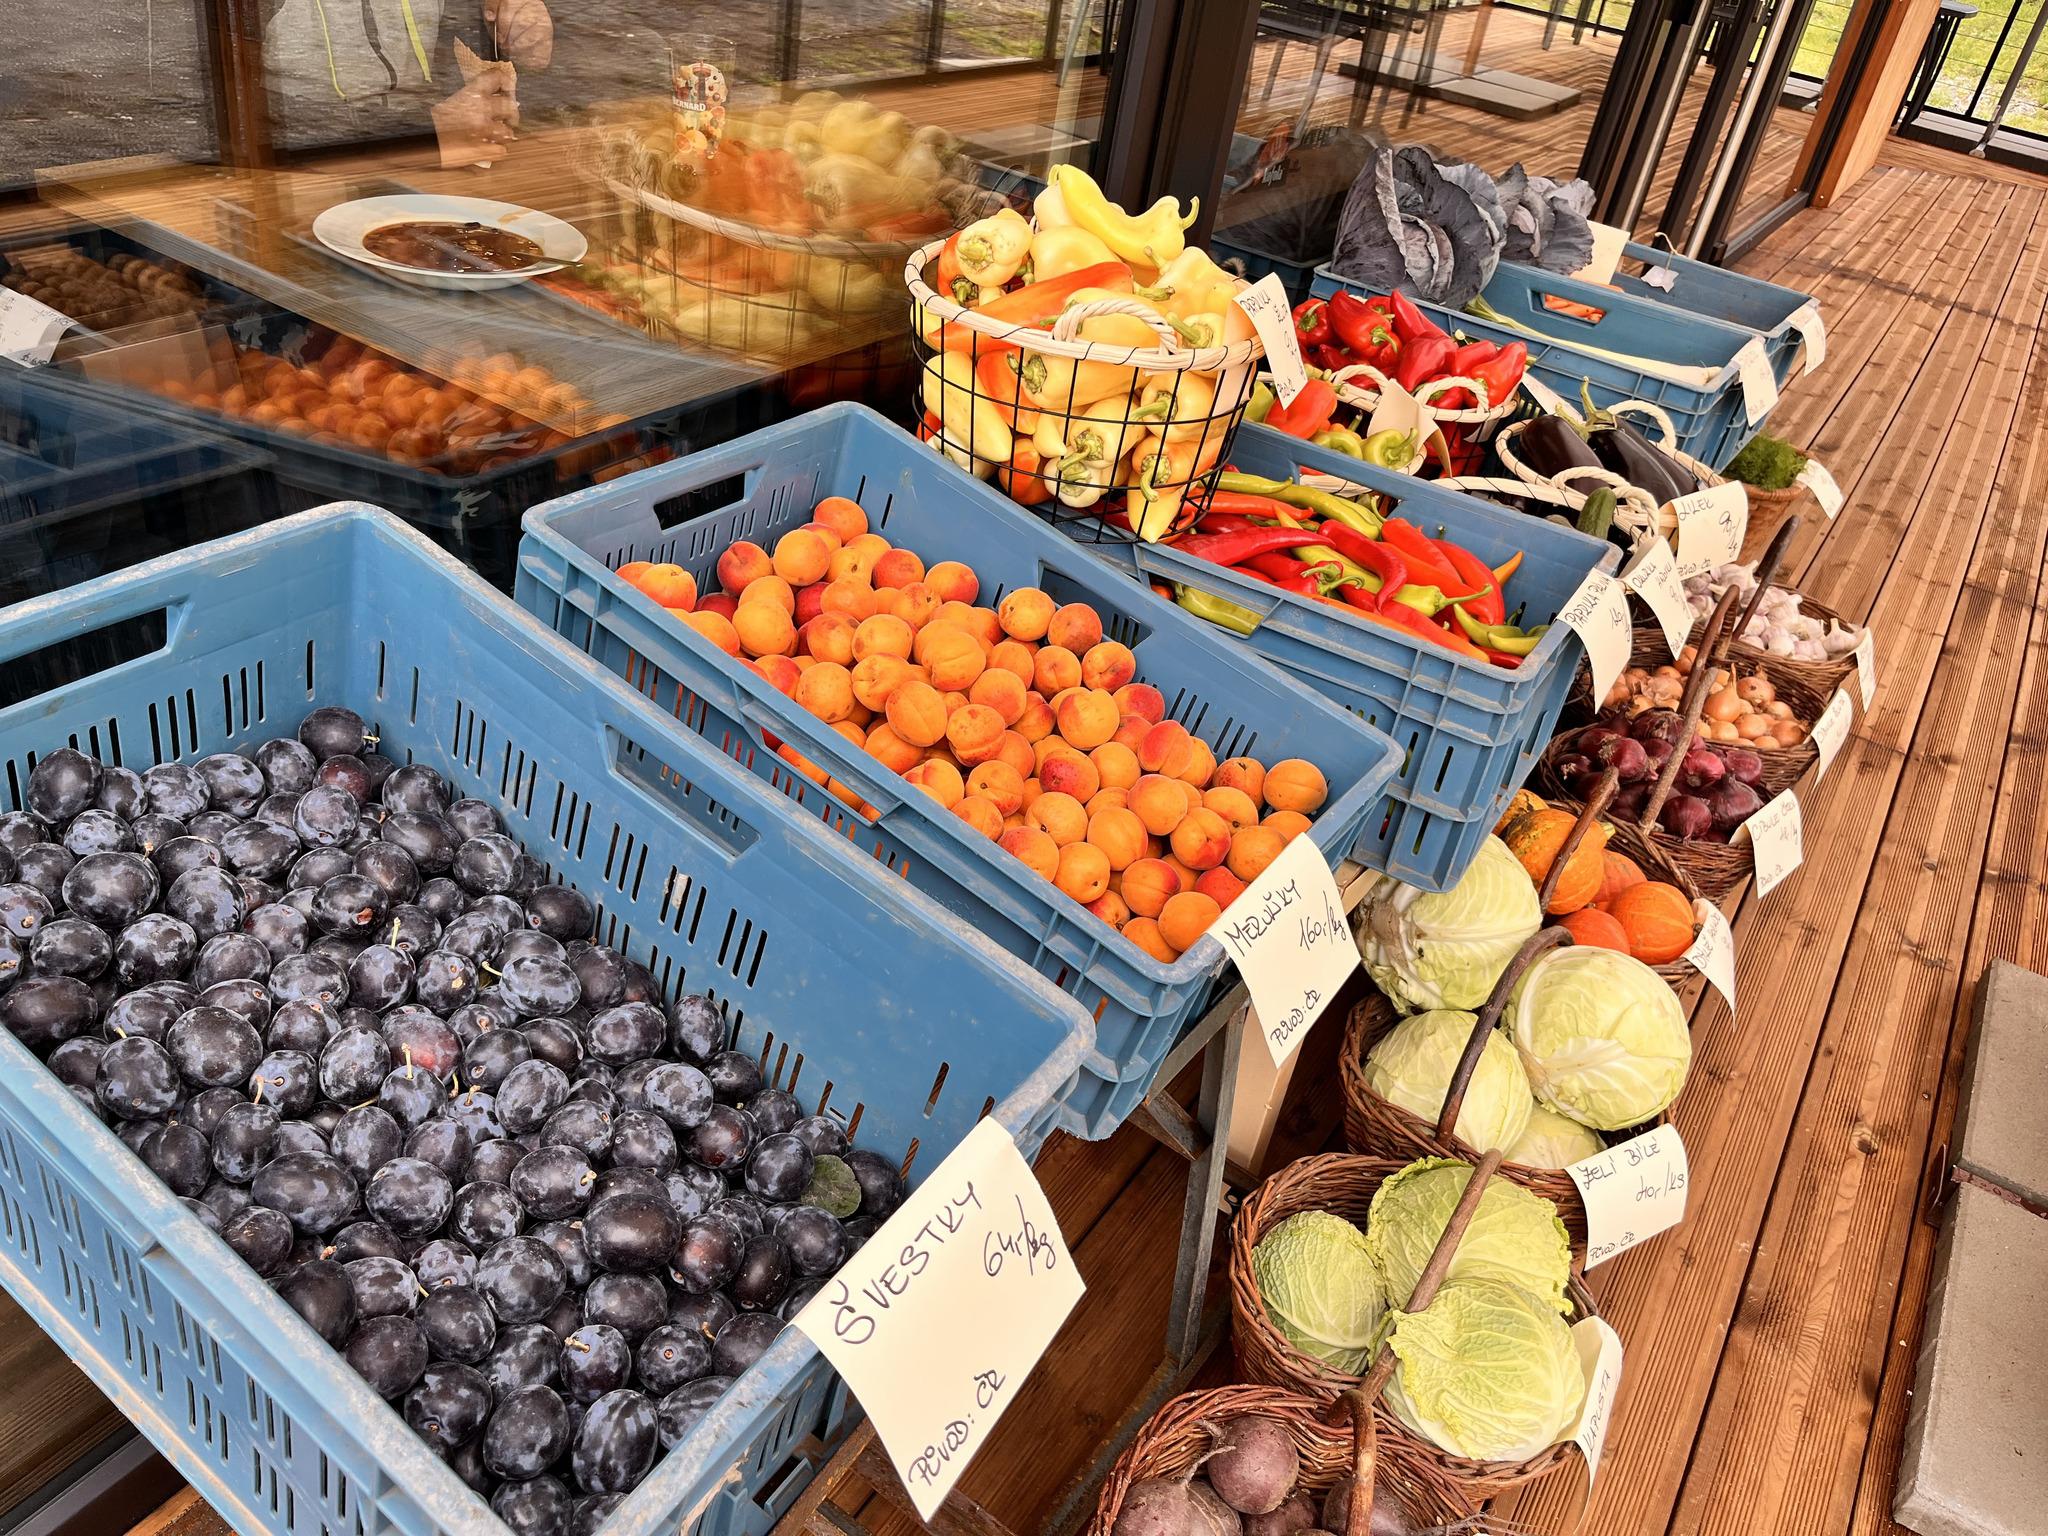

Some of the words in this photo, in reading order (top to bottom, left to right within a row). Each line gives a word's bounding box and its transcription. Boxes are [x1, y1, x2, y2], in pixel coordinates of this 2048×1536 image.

[1303, 988, 1322, 1011] ČR
[1623, 1136, 1661, 1167] BÍLÉ
[830, 1181, 982, 1345] ŠVESTKY
[908, 1413, 976, 1487] PŮVOD:
[973, 1369, 1006, 1410] ČR
